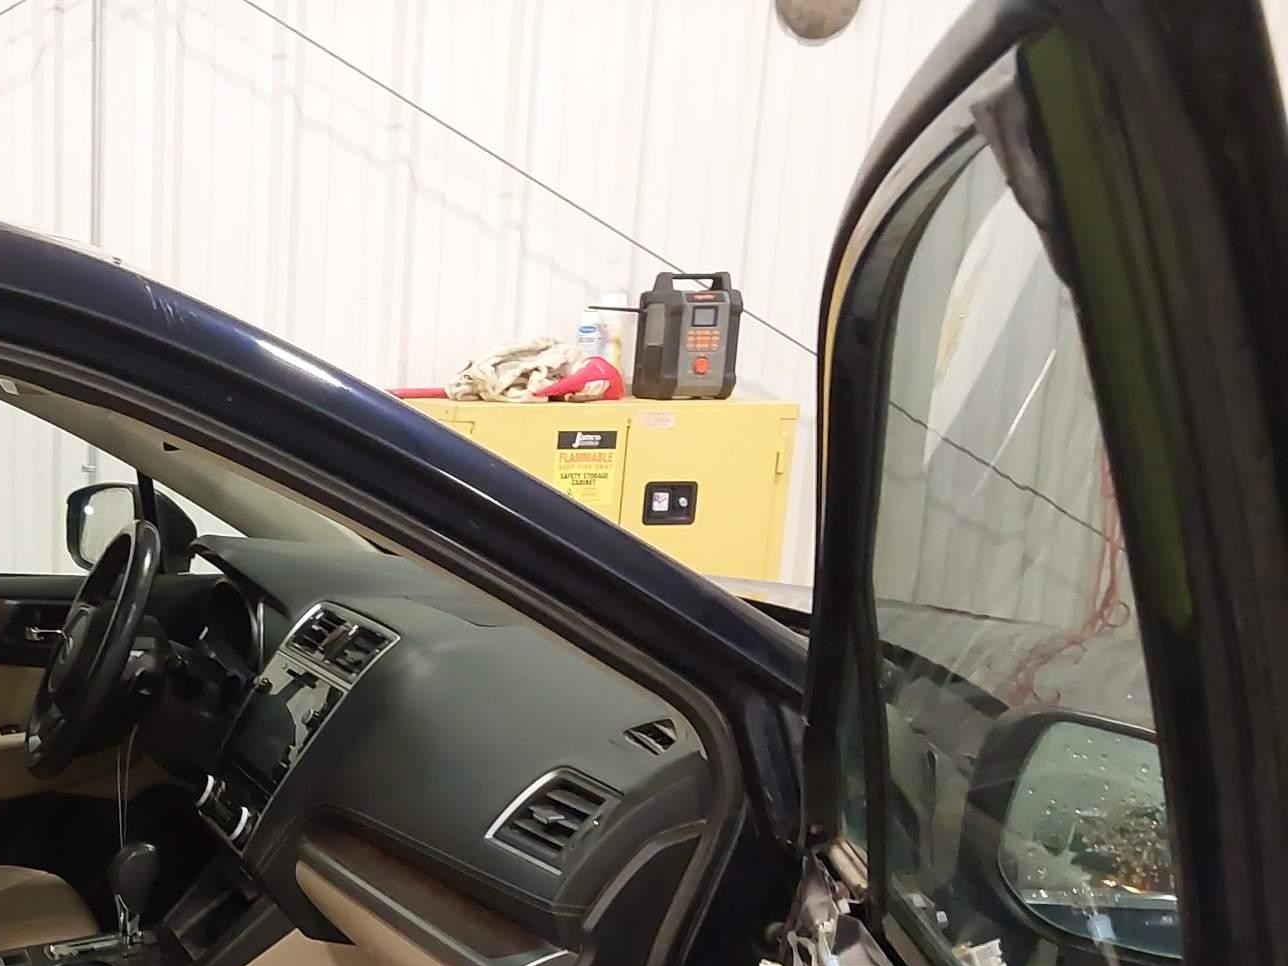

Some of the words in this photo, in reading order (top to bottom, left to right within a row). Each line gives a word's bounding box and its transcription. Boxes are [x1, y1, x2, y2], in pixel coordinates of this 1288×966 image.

[559, 452, 614, 463] FLAMMABLE
[559, 472, 581, 480] SAFETY
[583, 472, 609, 480] STORAGE
